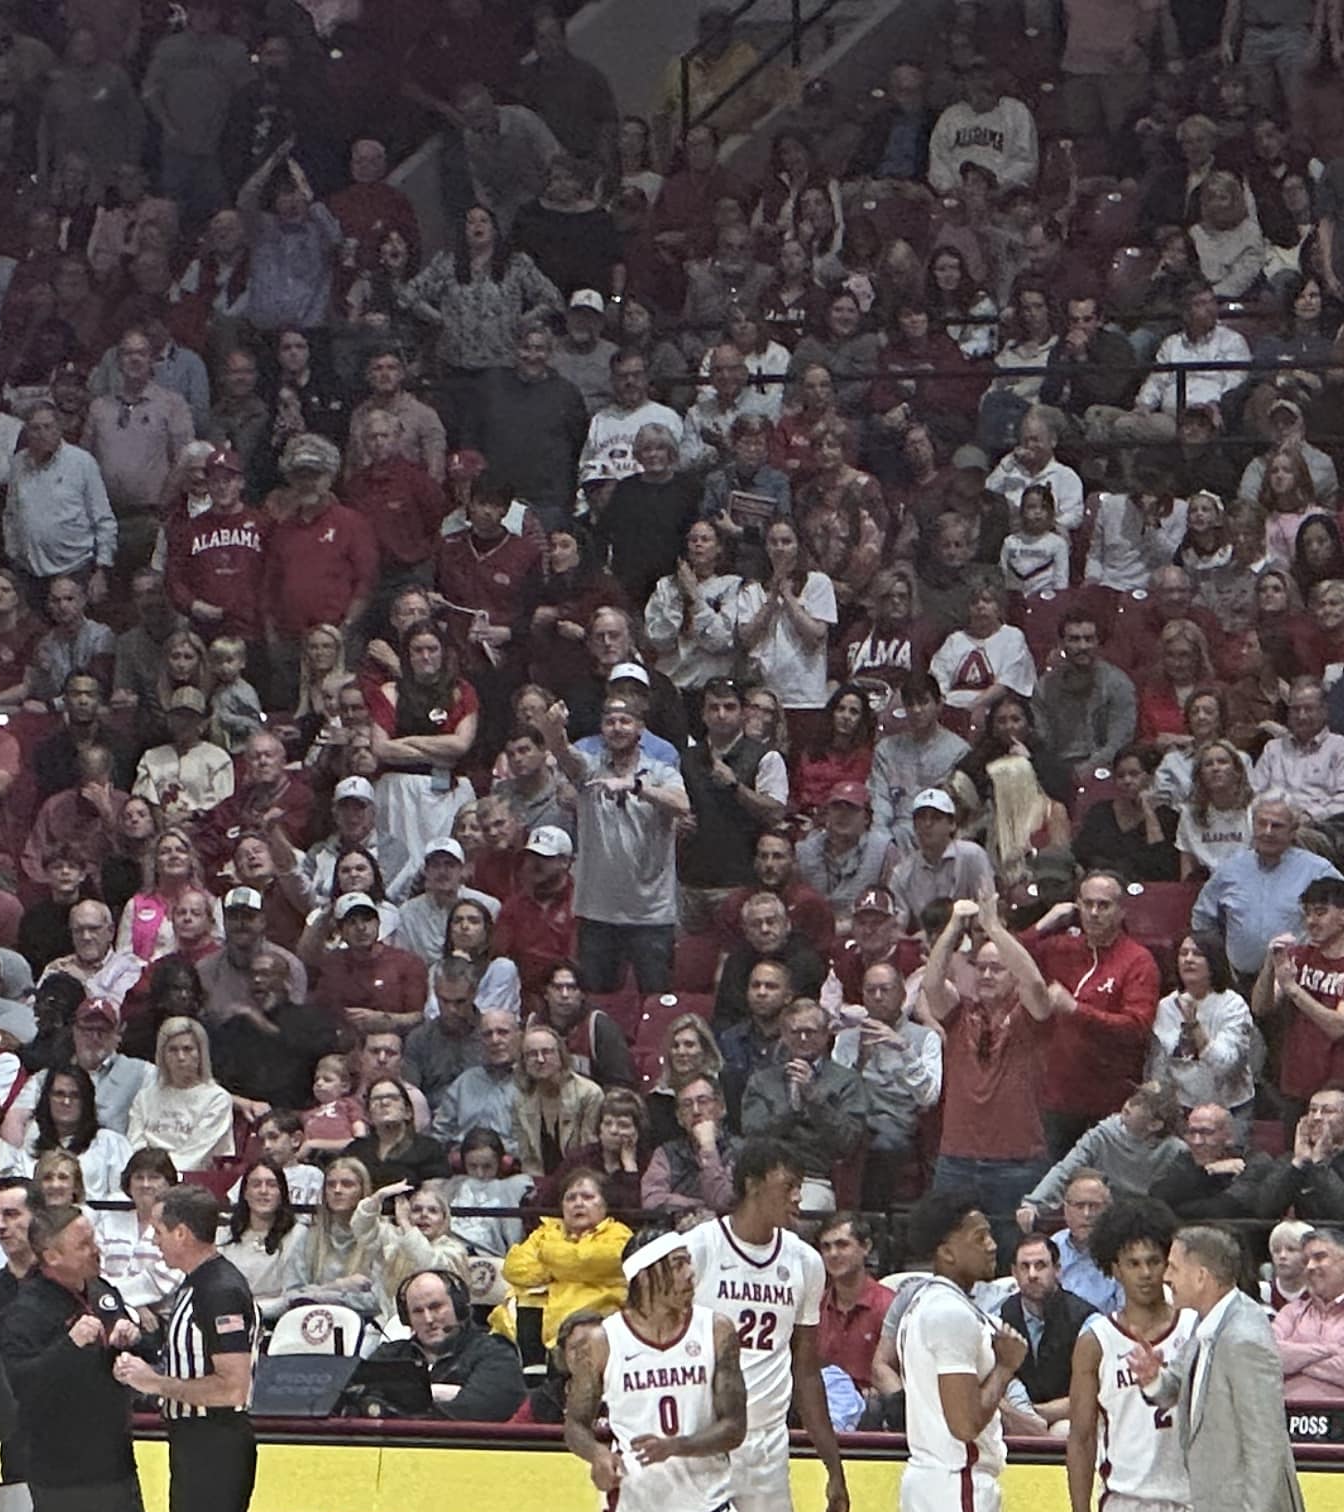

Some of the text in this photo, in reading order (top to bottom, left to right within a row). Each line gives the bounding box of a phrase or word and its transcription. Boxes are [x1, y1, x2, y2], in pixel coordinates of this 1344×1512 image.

[191, 528, 261, 555] ALABAMA
[717, 1280, 794, 1306] ALABAMA
[738, 1309, 777, 1351] 22
[623, 1366, 707, 1392] ALABAMA
[659, 1395, 679, 1436] 0
[1289, 1416, 1328, 1435] POSS
